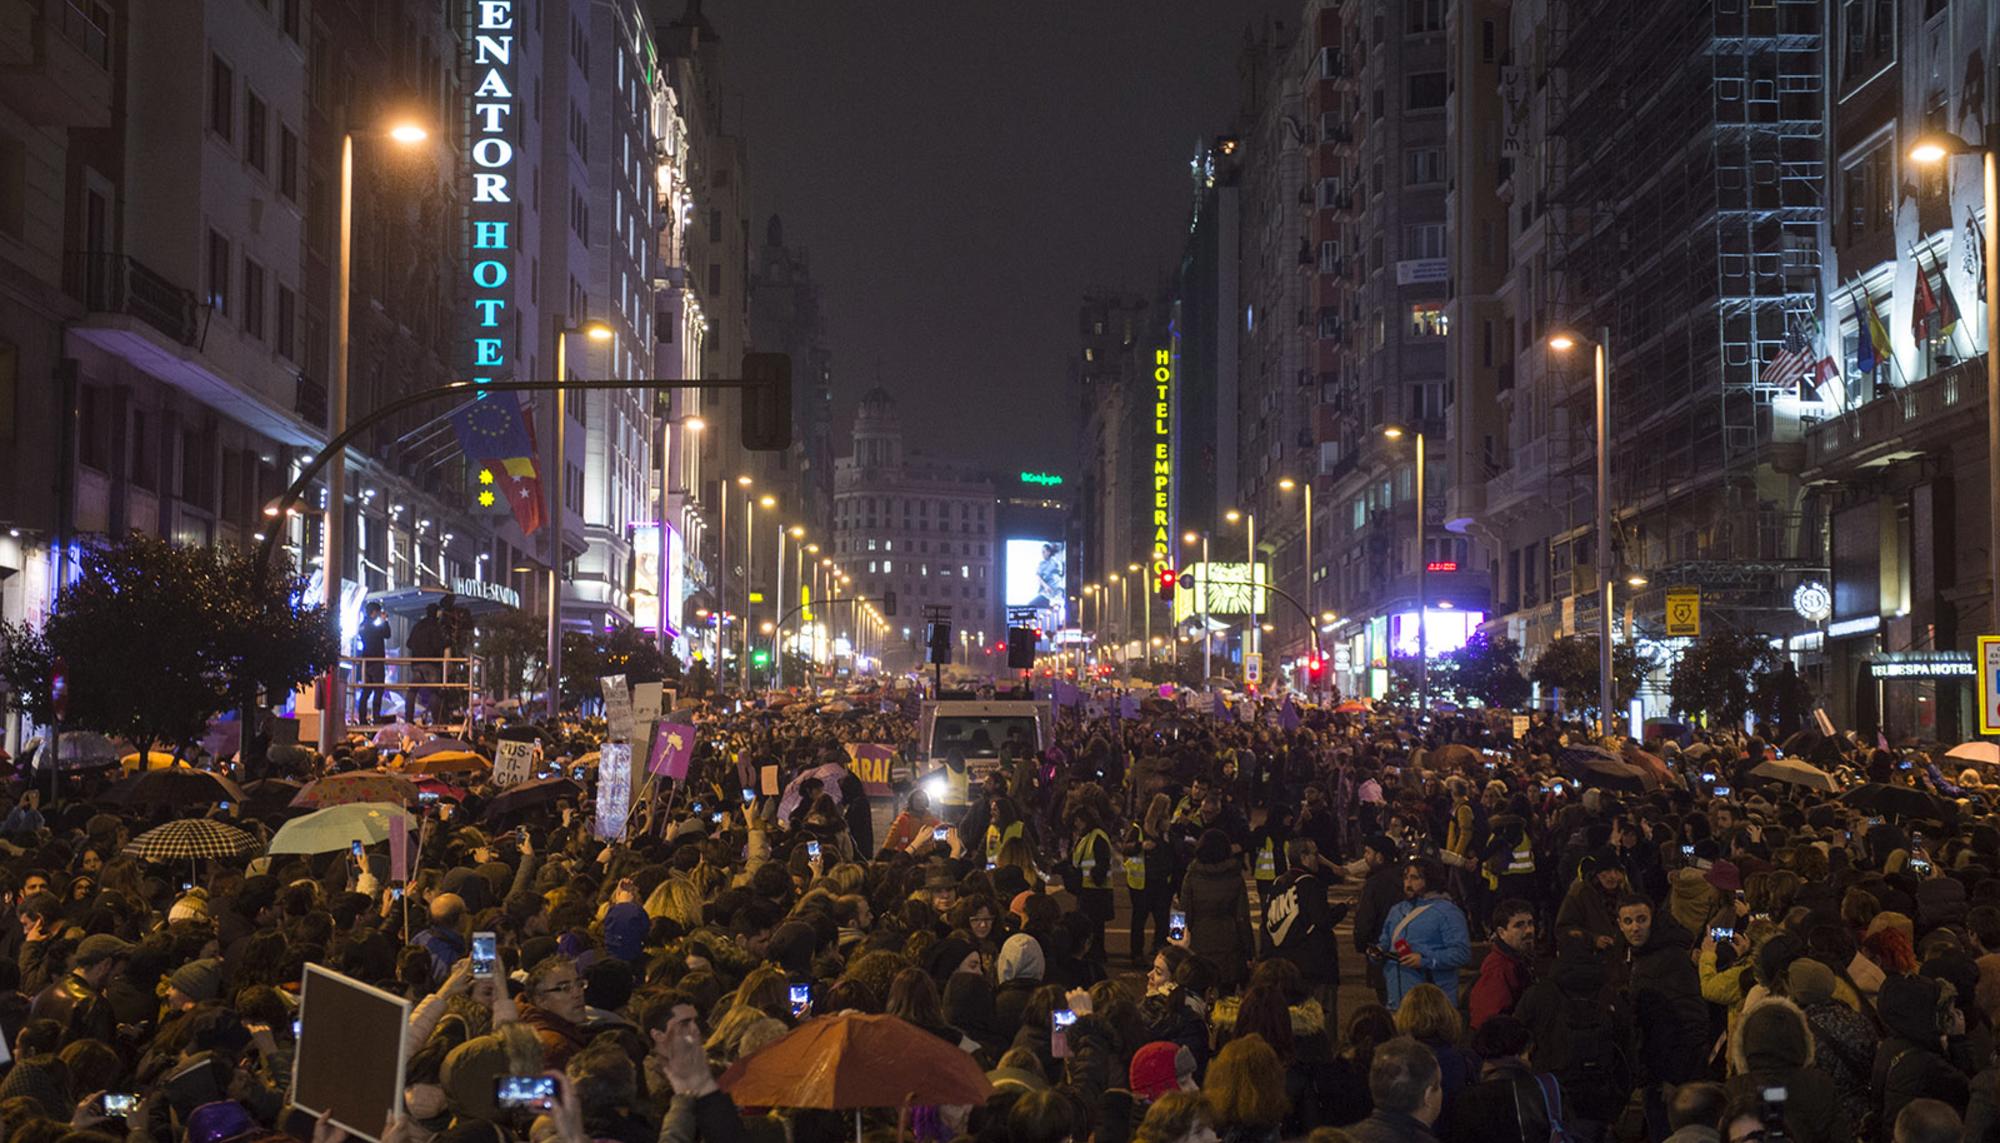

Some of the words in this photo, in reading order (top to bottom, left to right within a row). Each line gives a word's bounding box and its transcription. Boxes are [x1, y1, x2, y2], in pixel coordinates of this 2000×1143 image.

[1154, 349, 1169, 435] HOTEL
[458, 577, 489, 600] HOTEL
[1930, 663, 1977, 675] HOTEL
[1267, 885, 1299, 928] NIKE
